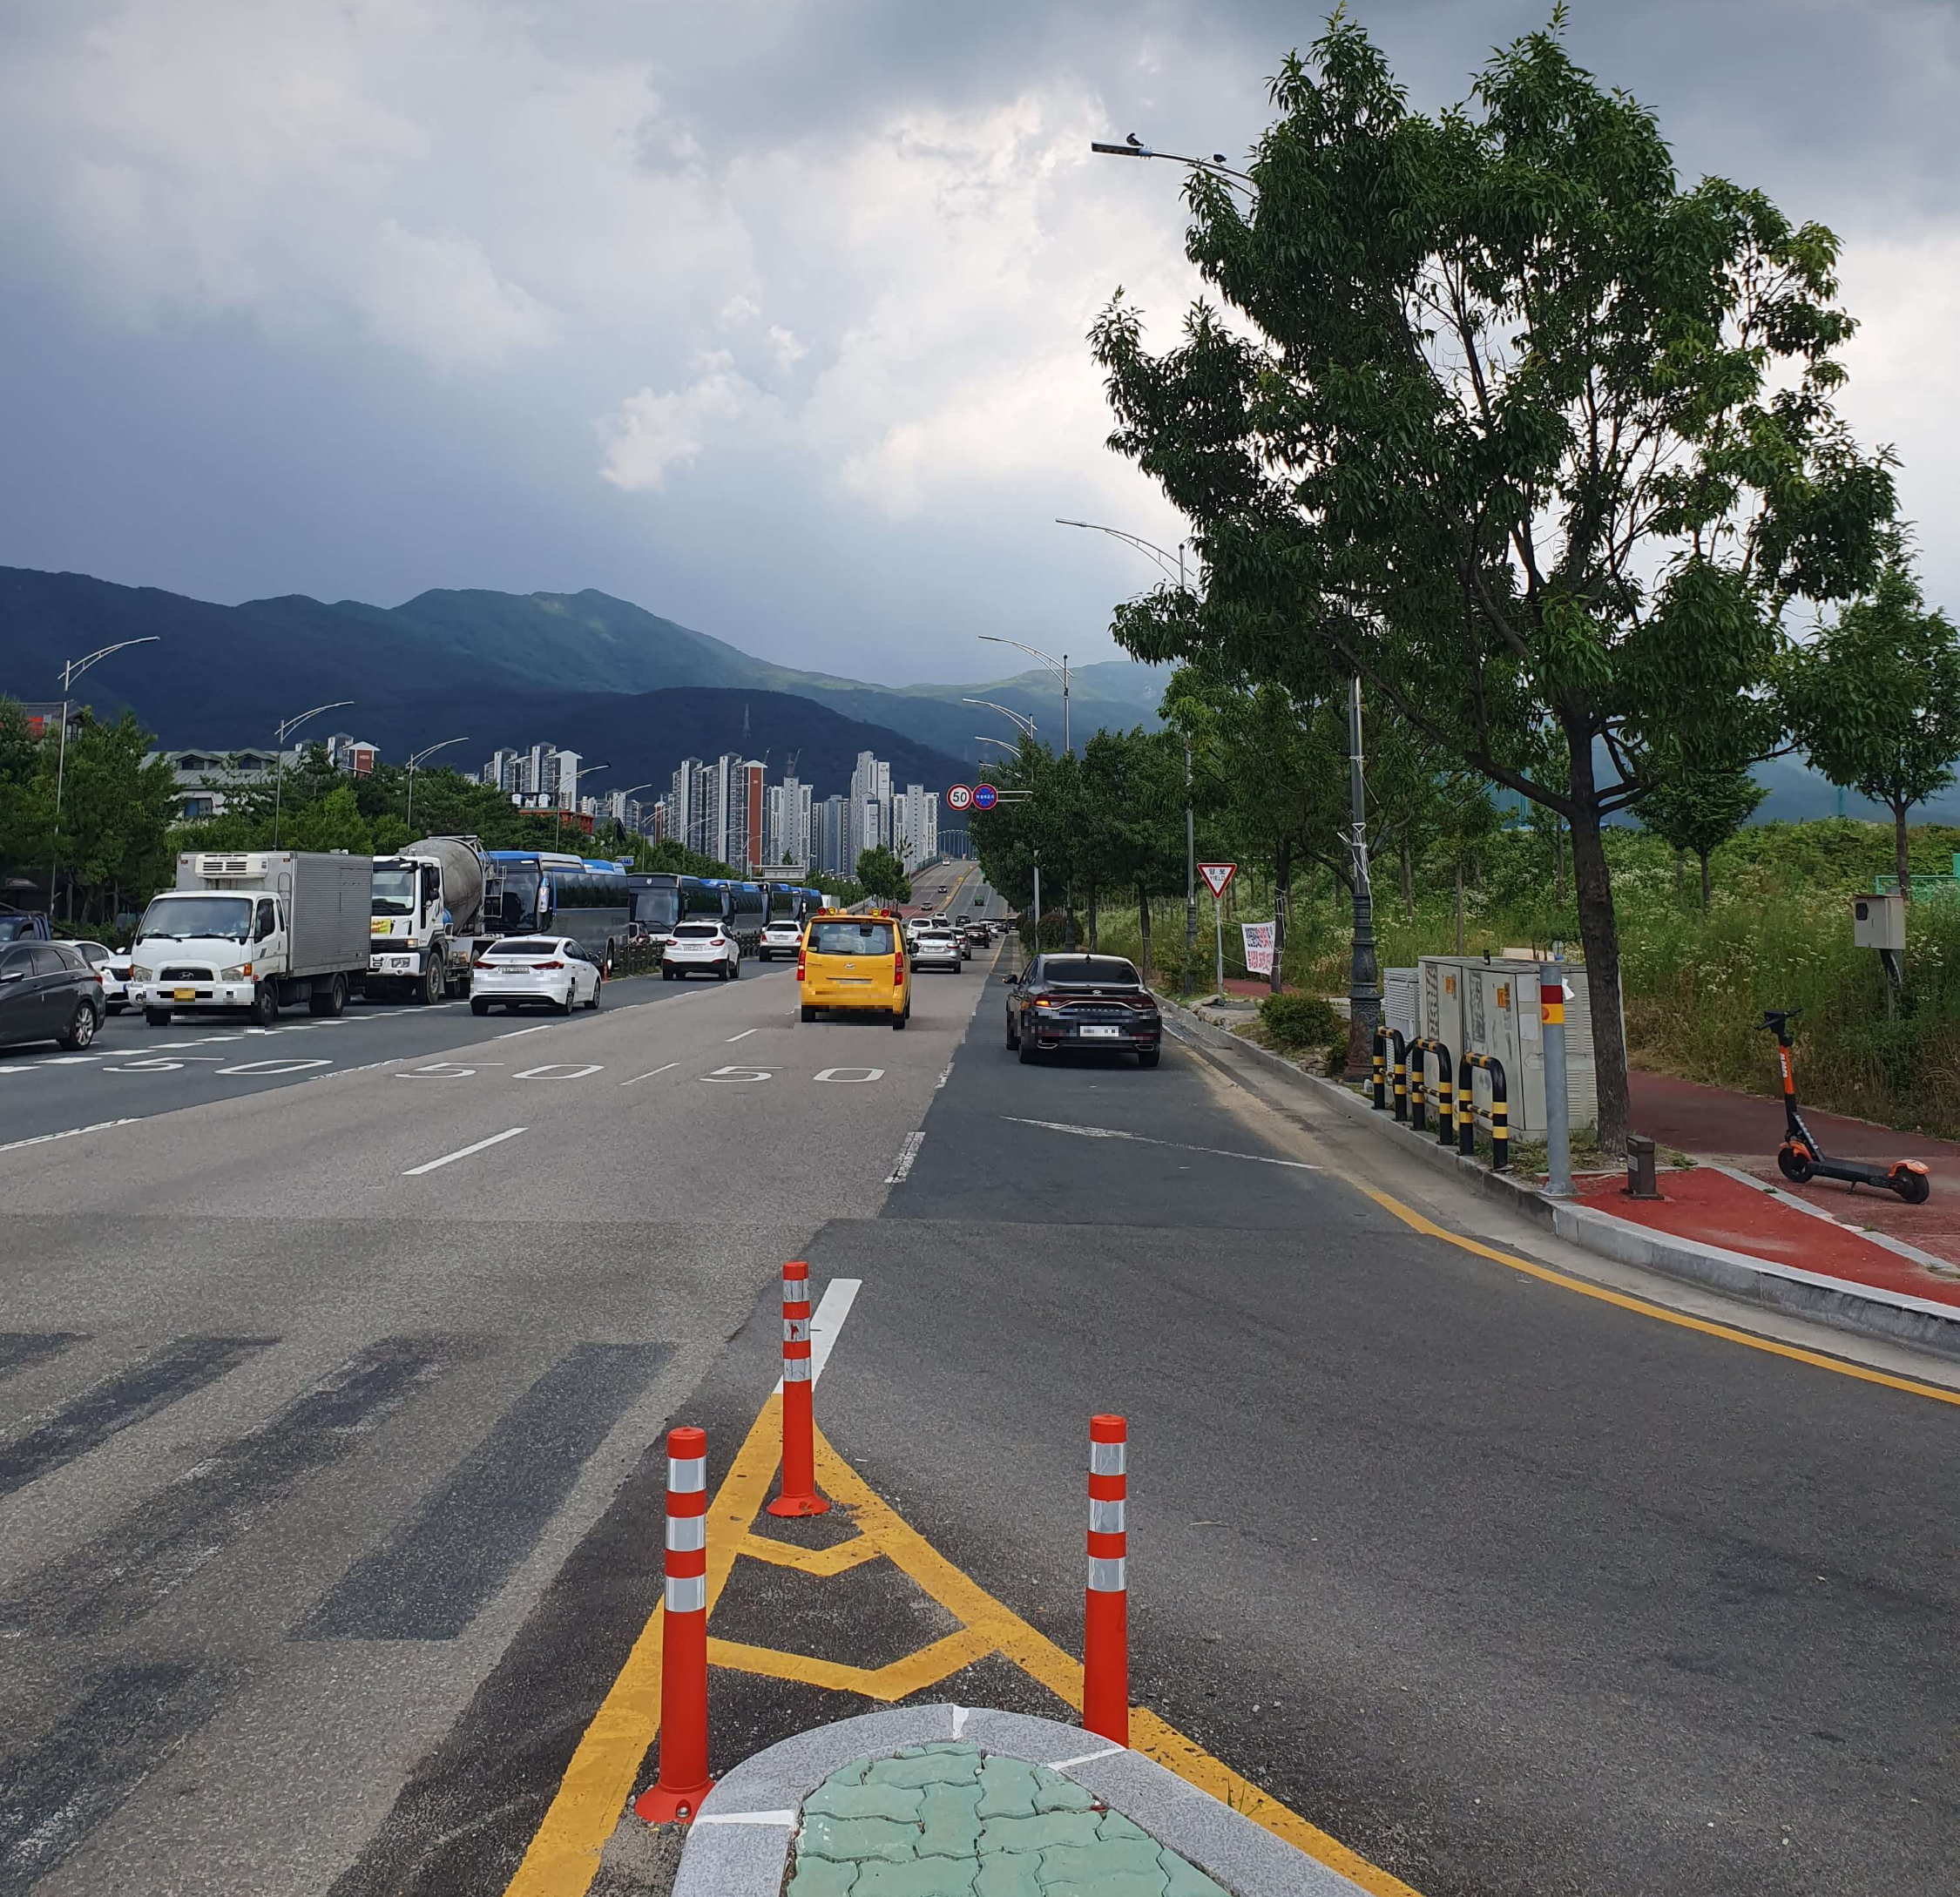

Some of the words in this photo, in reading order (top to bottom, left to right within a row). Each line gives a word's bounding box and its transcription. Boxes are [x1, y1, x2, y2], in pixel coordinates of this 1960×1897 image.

[952, 792, 967, 802] 50
[103, 1057, 333, 1075] 50
[395, 1063, 605, 1079] 50
[700, 1066, 885, 1082] 50
